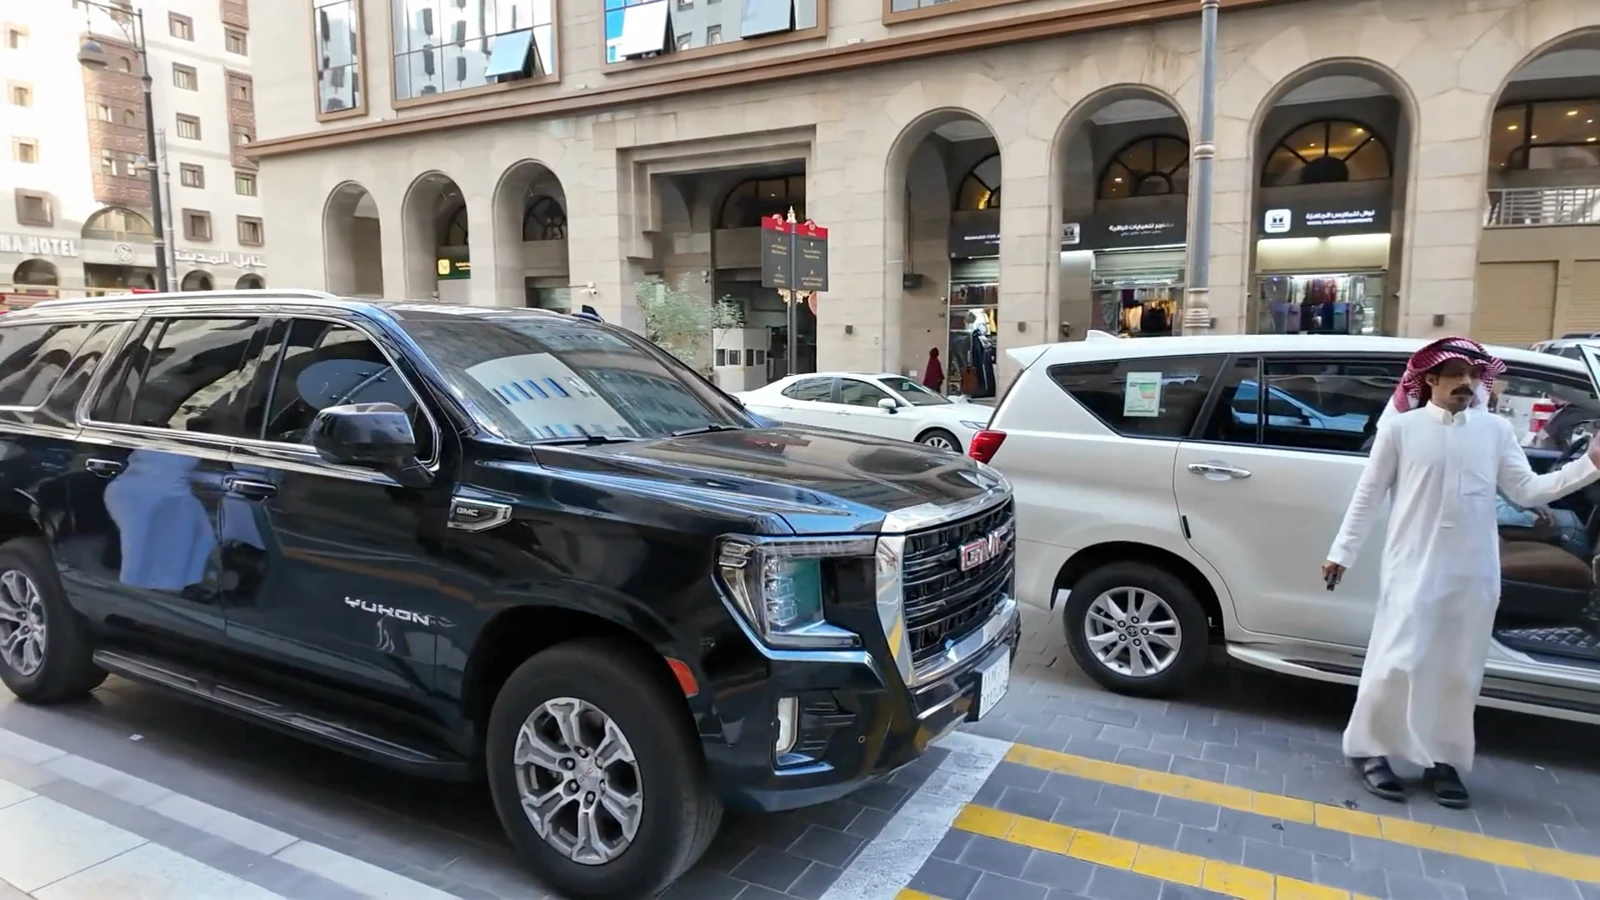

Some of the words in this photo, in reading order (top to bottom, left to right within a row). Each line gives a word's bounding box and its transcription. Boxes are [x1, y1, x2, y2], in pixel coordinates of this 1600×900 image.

[28, 236, 78, 257] HOTEL
[456, 506, 479, 517] GMC
[961, 527, 1009, 572] GMC
[344, 596, 430, 627] YUKON
